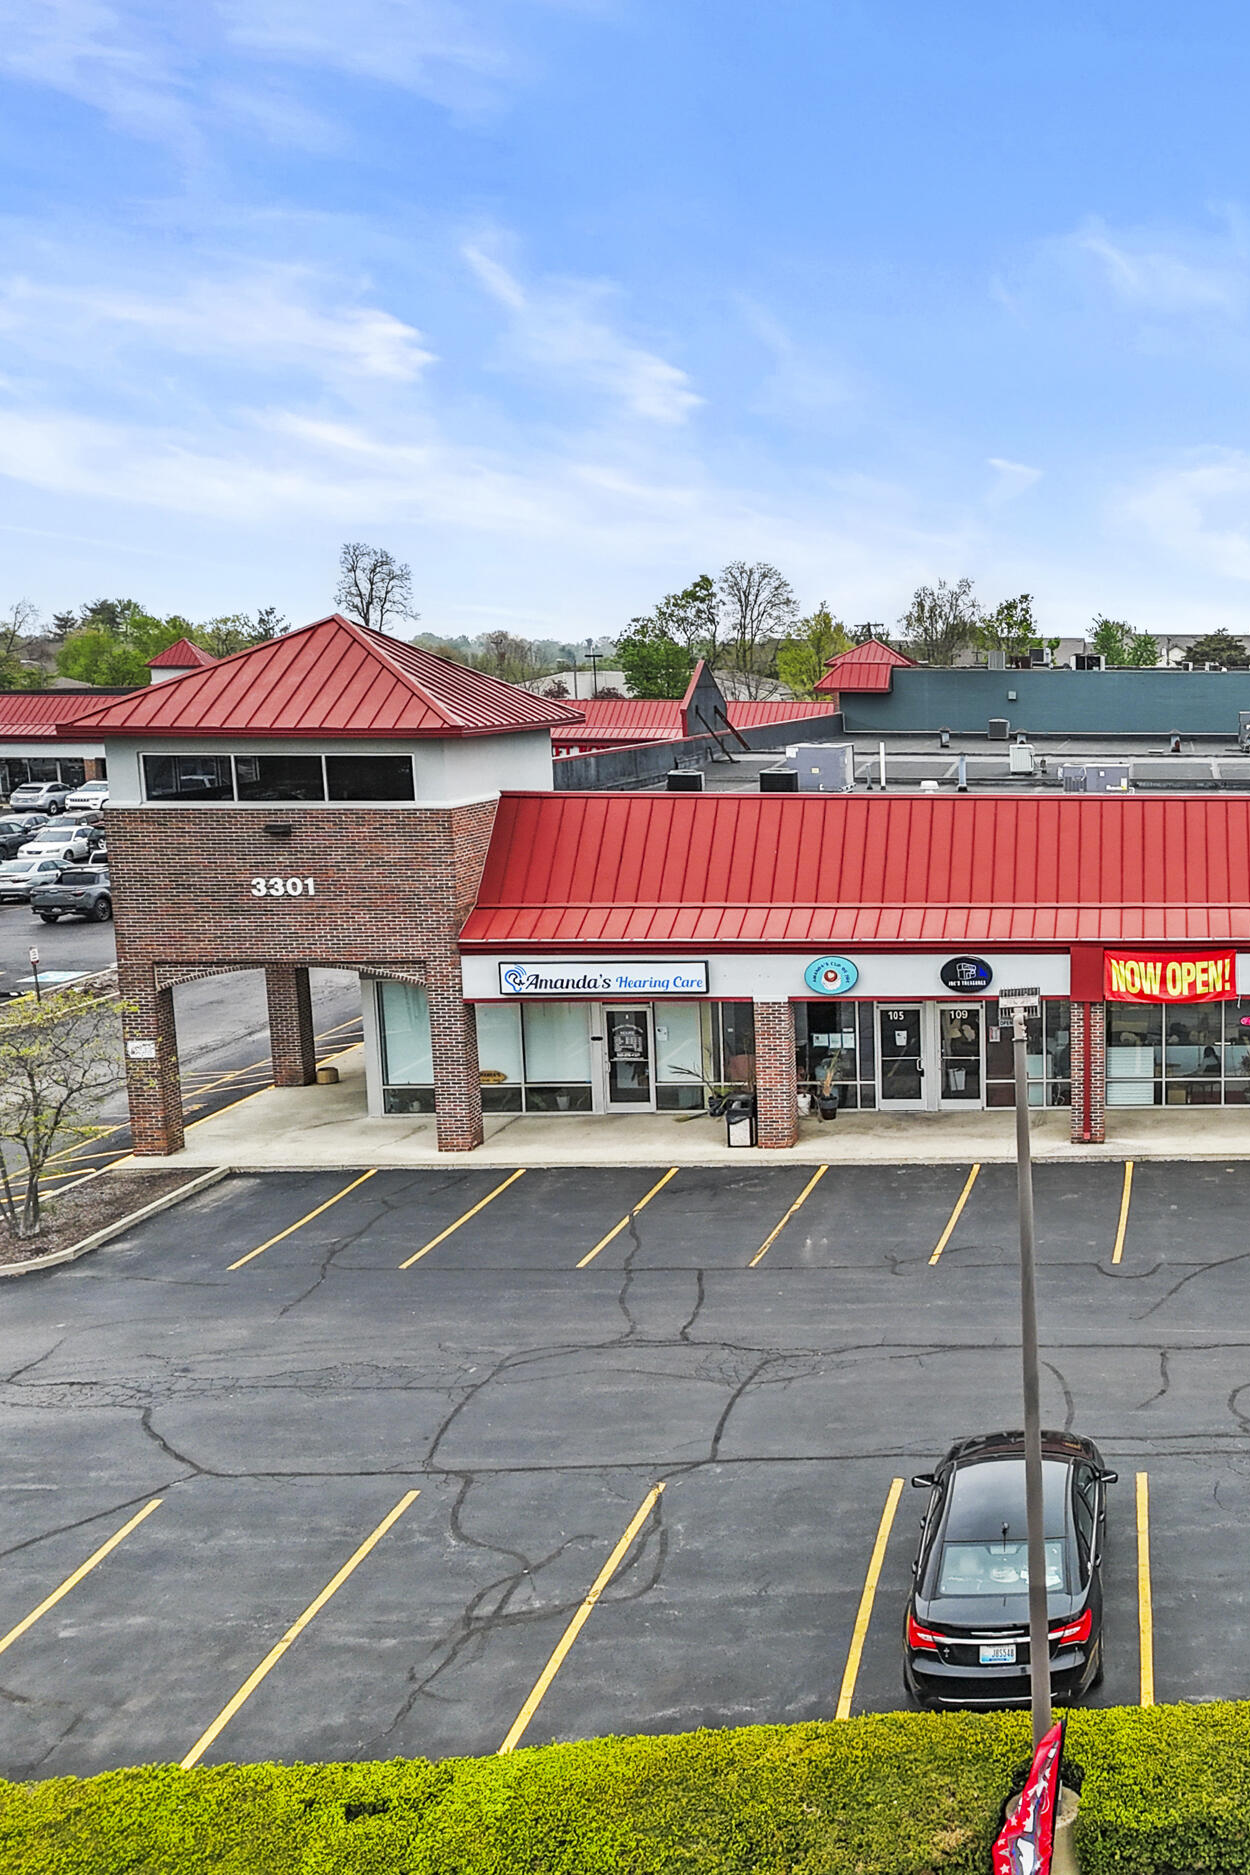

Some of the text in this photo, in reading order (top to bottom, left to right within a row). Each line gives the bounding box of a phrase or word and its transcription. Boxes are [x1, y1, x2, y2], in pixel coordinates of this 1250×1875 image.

[251, 877, 315, 897] 3301
[525, 973, 703, 990] Amanda's Hearing Care
[1110, 958, 1231, 996] NOW OPEN!
[888, 1011, 904, 1021] 105
[950, 1010, 968, 1020] 109
